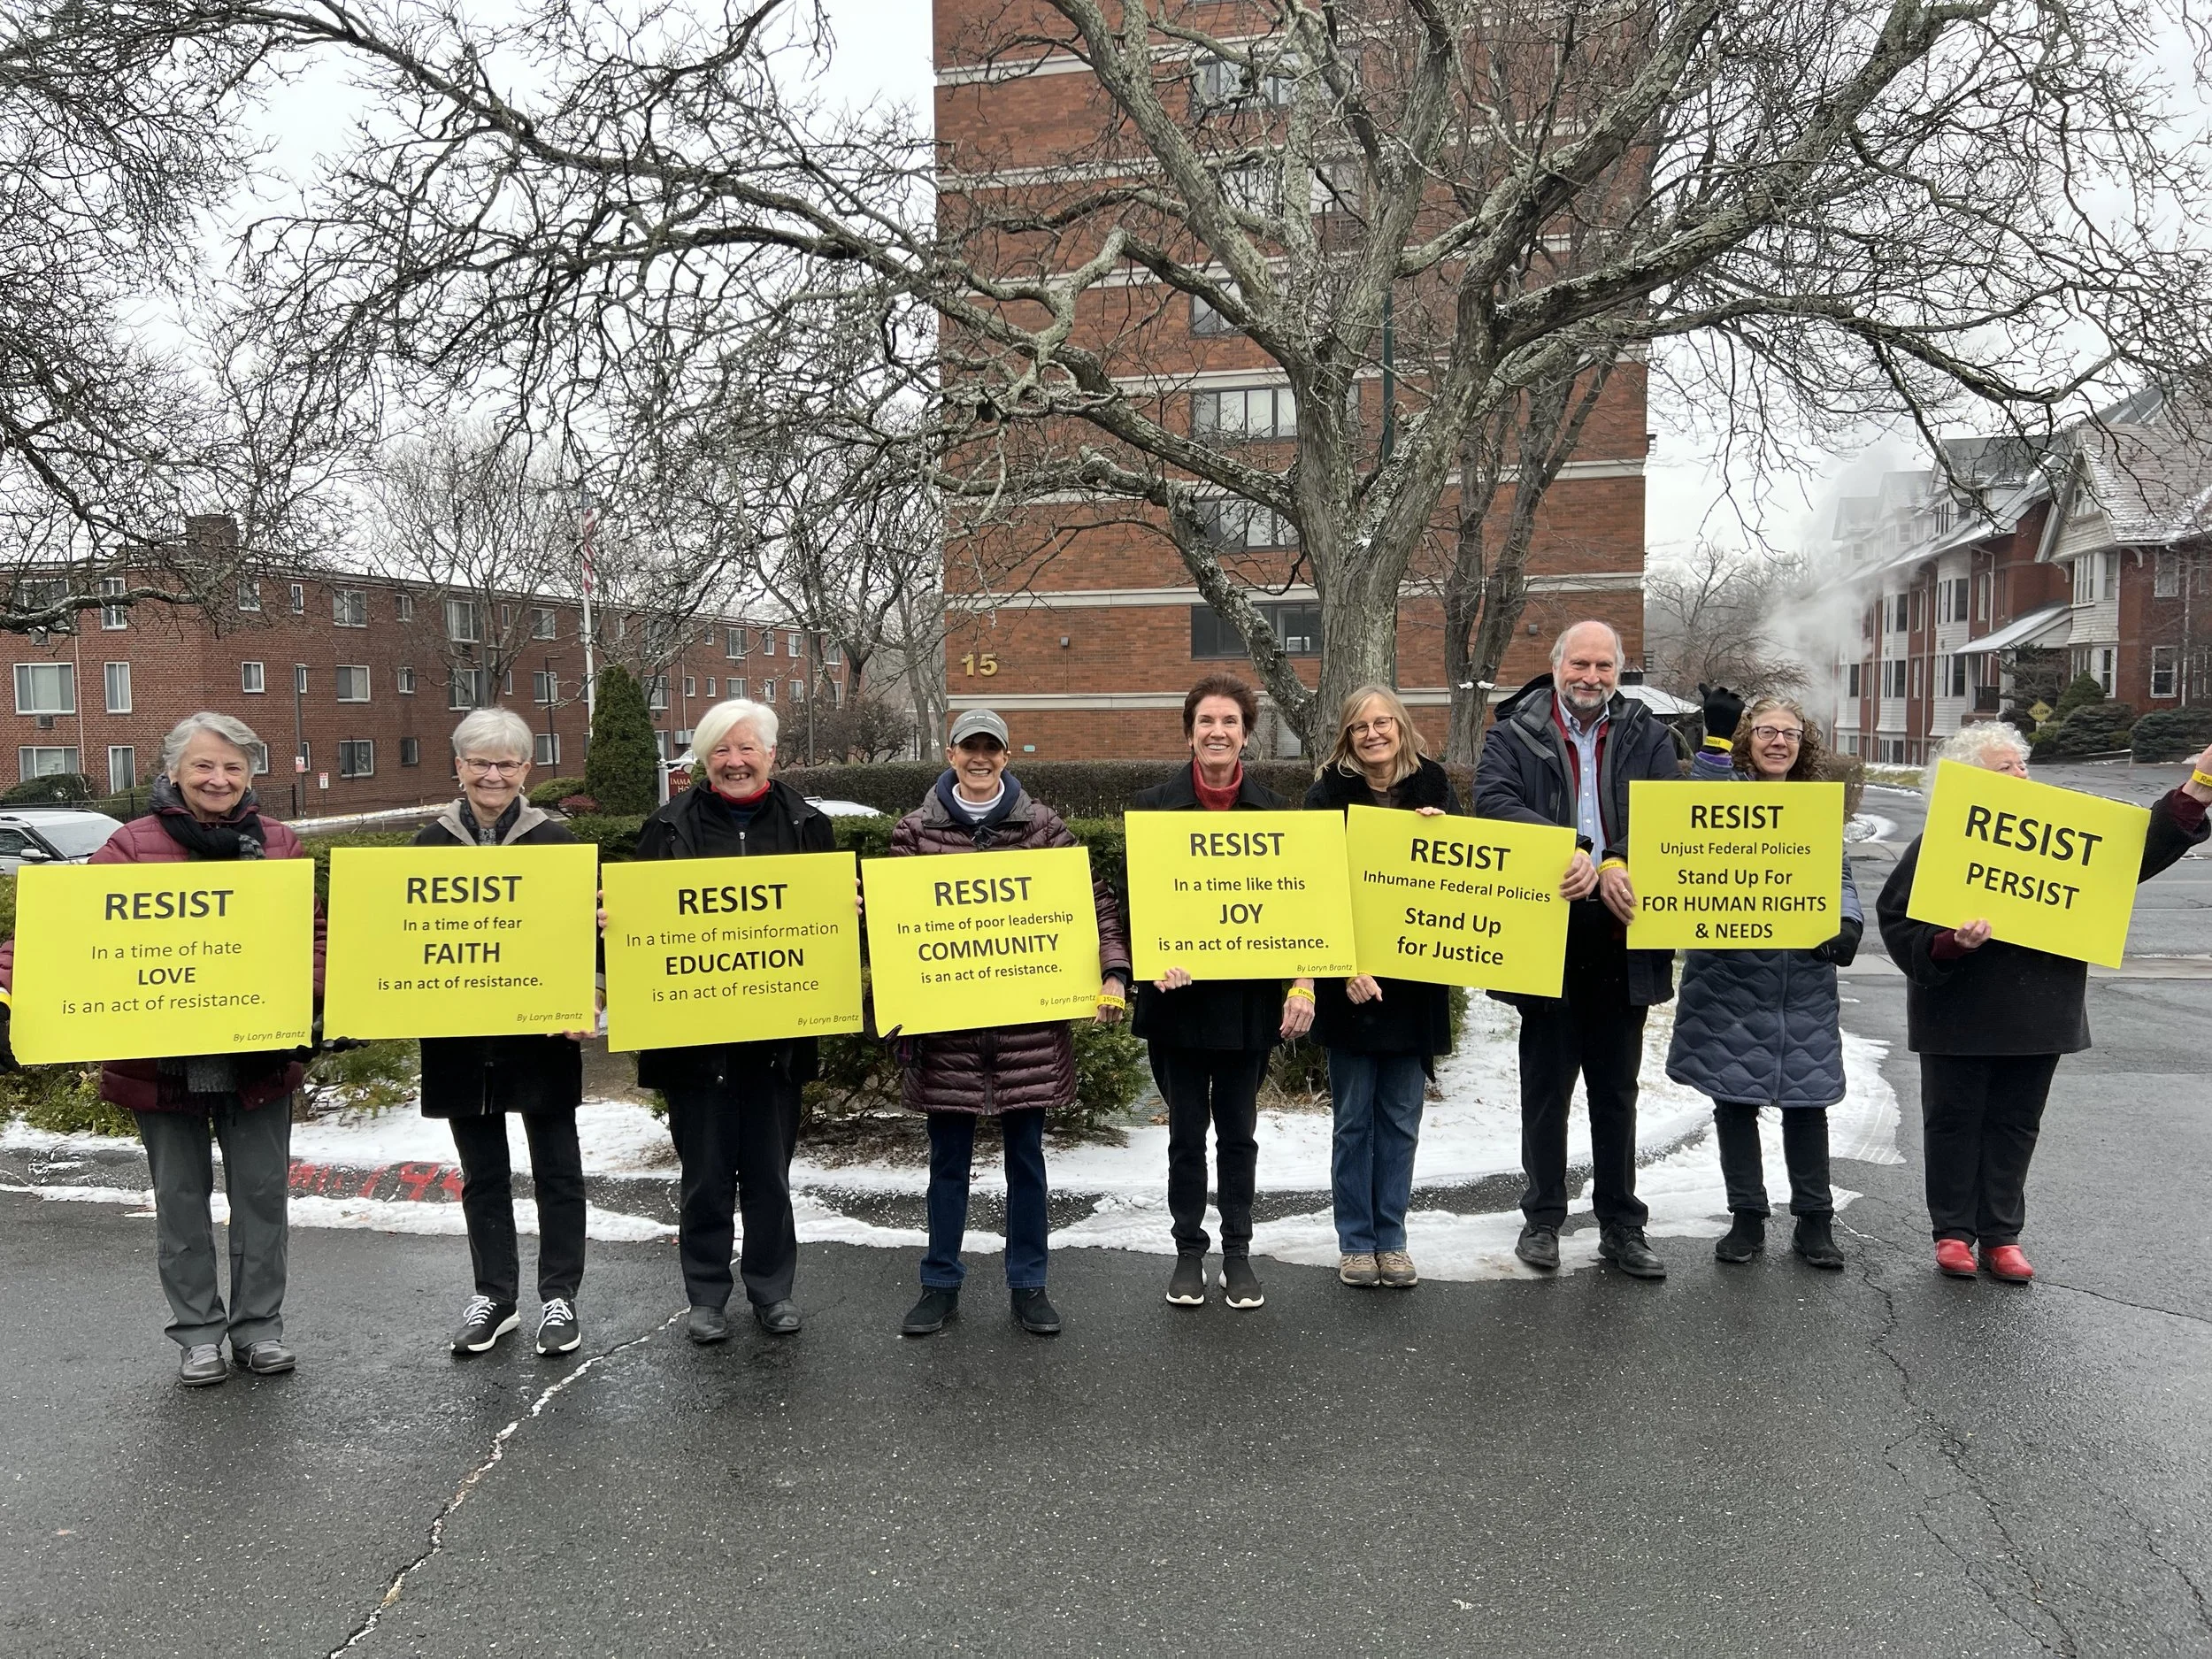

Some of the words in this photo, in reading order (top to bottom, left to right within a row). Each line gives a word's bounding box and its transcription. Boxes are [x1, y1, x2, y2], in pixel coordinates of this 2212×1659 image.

[961, 653, 998, 677] 15
[1691, 804, 1784, 829] RESIST
[1189, 832, 1285, 856] RESIST
[1964, 804, 2102, 866] RESIST
[1410, 837, 1511, 872] RESIST
[1660, 841, 1704, 856] Unjust
[1708, 841, 1757, 854] Federal
[1761, 841, 1810, 855] Policies
[1174, 878, 1188, 891] In
[1193, 880, 1202, 891] a
[1206, 877, 1241, 891] time
[1246, 877, 1272, 890] like
[1276, 876, 1305, 890] this
[1363, 870, 1435, 889] Inhumane
[1440, 878, 1493, 895] Federal
[1496, 885, 1550, 902] Policies
[1677, 867, 1728, 885] Stand
[1734, 869, 1759, 888] Up
[1764, 869, 1793, 885] For
[1965, 862, 2080, 910] PERSIST
[406, 875, 522, 903] RESIST
[678, 883, 787, 915] RESIST
[933, 876, 1032, 906] RESIST
[104, 889, 234, 920] RESIST
[1219, 903, 1263, 924] JOY
[1642, 895, 1678, 911] FOR
[1684, 895, 1755, 912] HUMAN
[1762, 895, 1826, 911] RIGHTS
[403, 918, 417, 931] In
[421, 921, 429, 930] a
[434, 918, 469, 930] time
[472, 916, 489, 929] of
[492, 916, 522, 929] fear
[897, 923, 910, 933] In
[913, 924, 920, 933] a
[924, 920, 955, 932] time
[958, 917, 972, 929] of
[975, 918, 1004, 931] poor
[1008, 910, 1073, 926] leadership
[1404, 907, 1465, 930] Stand
[1472, 914, 1501, 938] Up
[1694, 922, 1709, 939] &
[1715, 923, 1772, 938] NEEDS
[626, 933, 641, 947] In
[646, 934, 655, 946] a
[659, 930, 695, 944] time
[701, 927, 718, 941] of
[722, 922, 838, 941] misinformation
[1158, 937, 1170, 950] is
[1174, 940, 1193, 950] an
[1198, 938, 1222, 950] act
[1225, 935, 1241, 950] of
[1246, 935, 1328, 949] resistance.
[92, 946, 107, 959] In
[114, 948, 124, 958] a
[130, 943, 172, 957] time
[179, 941, 197, 956] of
[203, 941, 242, 955] hate
[424, 941, 500, 964] FAITH
[918, 933, 1058, 961] COMMUNITY
[1396, 935, 1427, 956] for
[1432, 941, 1503, 965] Justice
[665, 948, 803, 975] EDUCATION
[1296, 964, 1305, 973] By
[1307, 964, 1326, 973] Loryn
[138, 966, 196, 985] LOVE
[378, 978, 389, 990] is
[394, 979, 411, 989] an
[417, 978, 440, 989] act
[444, 975, 460, 988] of
[464, 974, 542, 987] resistance.
[920, 972, 931, 983] is
[935, 972, 950, 982] an
[955, 969, 974, 980] act
[978, 965, 991, 979] of
[995, 964, 1062, 977] resistance.
[652, 988, 664, 1002] is
[669, 989, 687, 1001] an
[693, 985, 717, 999] act
[721, 981, 738, 996] of
[742, 979, 818, 995] resistance
[1103, 996, 1124, 1007] Resist
[62, 999, 75, 1014] is
[82, 1002, 104, 1013] an
[111, 997, 139, 1011] act
[145, 995, 165, 1010] of
[170, 994, 265, 1009] resistance.
[1040, 998, 1048, 1007] By
[517, 1013, 527, 1023] By
[529, 1013, 552, 1022] Loryn
[797, 1018, 807, 1027] By
[809, 1017, 831, 1025] Loryn
[233, 1033, 244, 1043] By
[247, 1033, 273, 1041] Loryn
